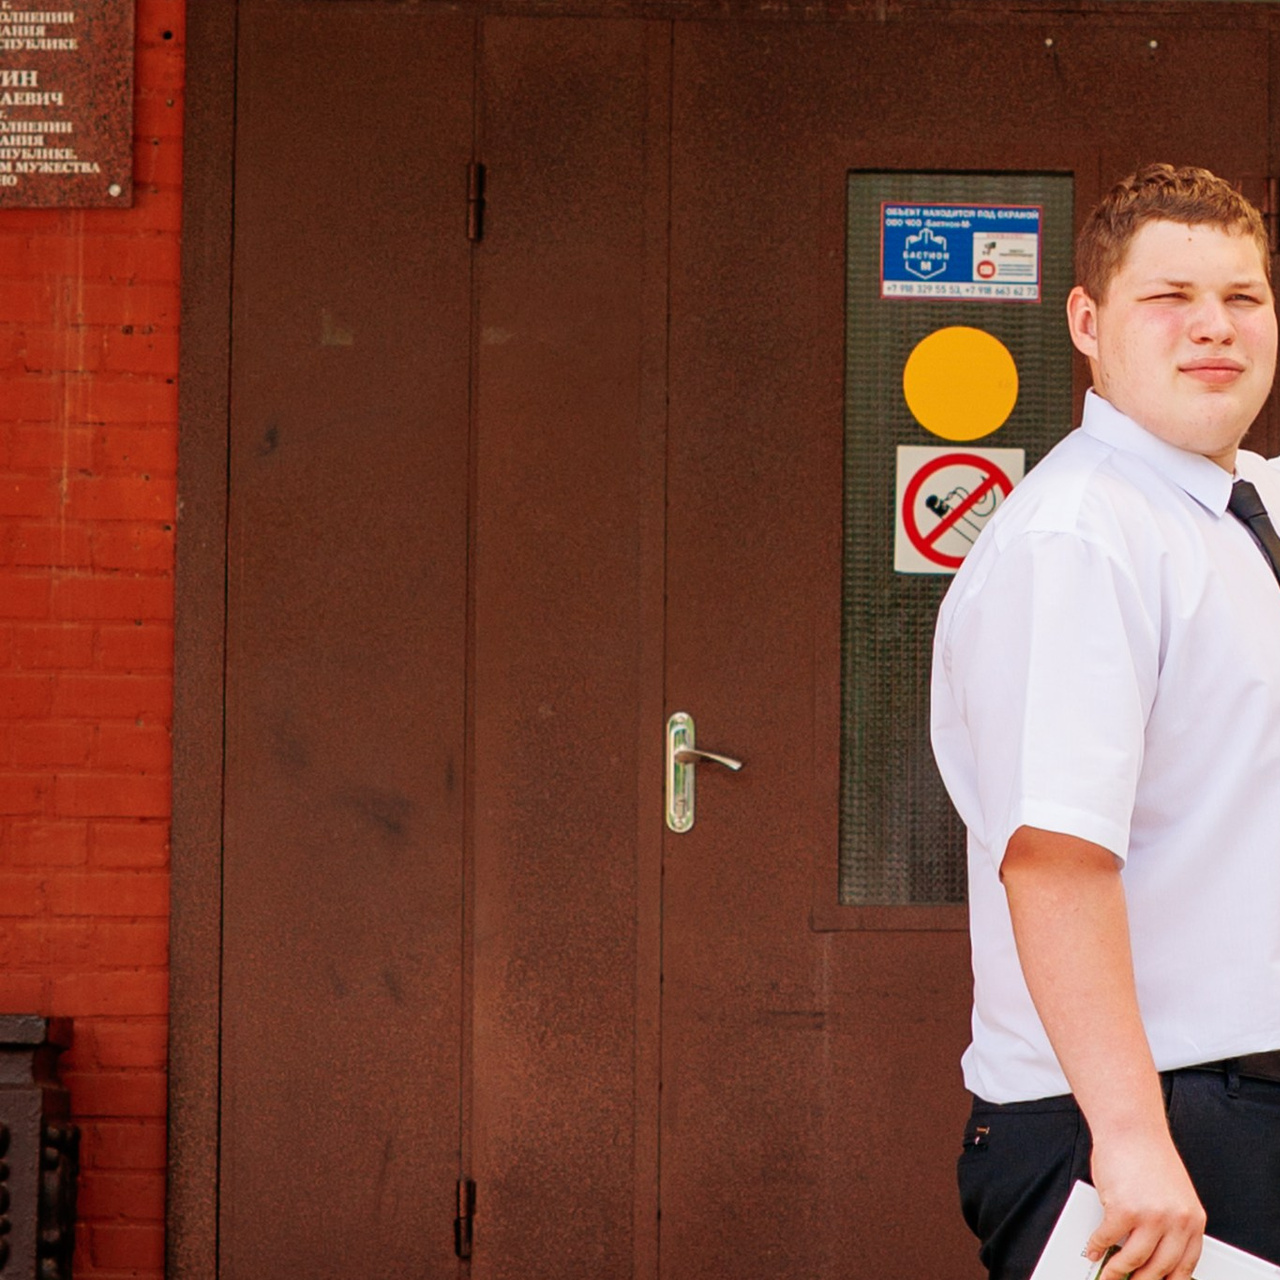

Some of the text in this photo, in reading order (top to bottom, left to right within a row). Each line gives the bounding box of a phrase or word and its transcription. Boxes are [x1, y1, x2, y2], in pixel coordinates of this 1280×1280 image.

[0, 24, 46, 37] АНИЯ
[0, 70, 38, 87] ИН
[0, 91, 64, 106] АЕВИЧ
[15, 161, 101, 174] МУЖЕСТВА
[903, 251, 950, 260] БАСТИОН
